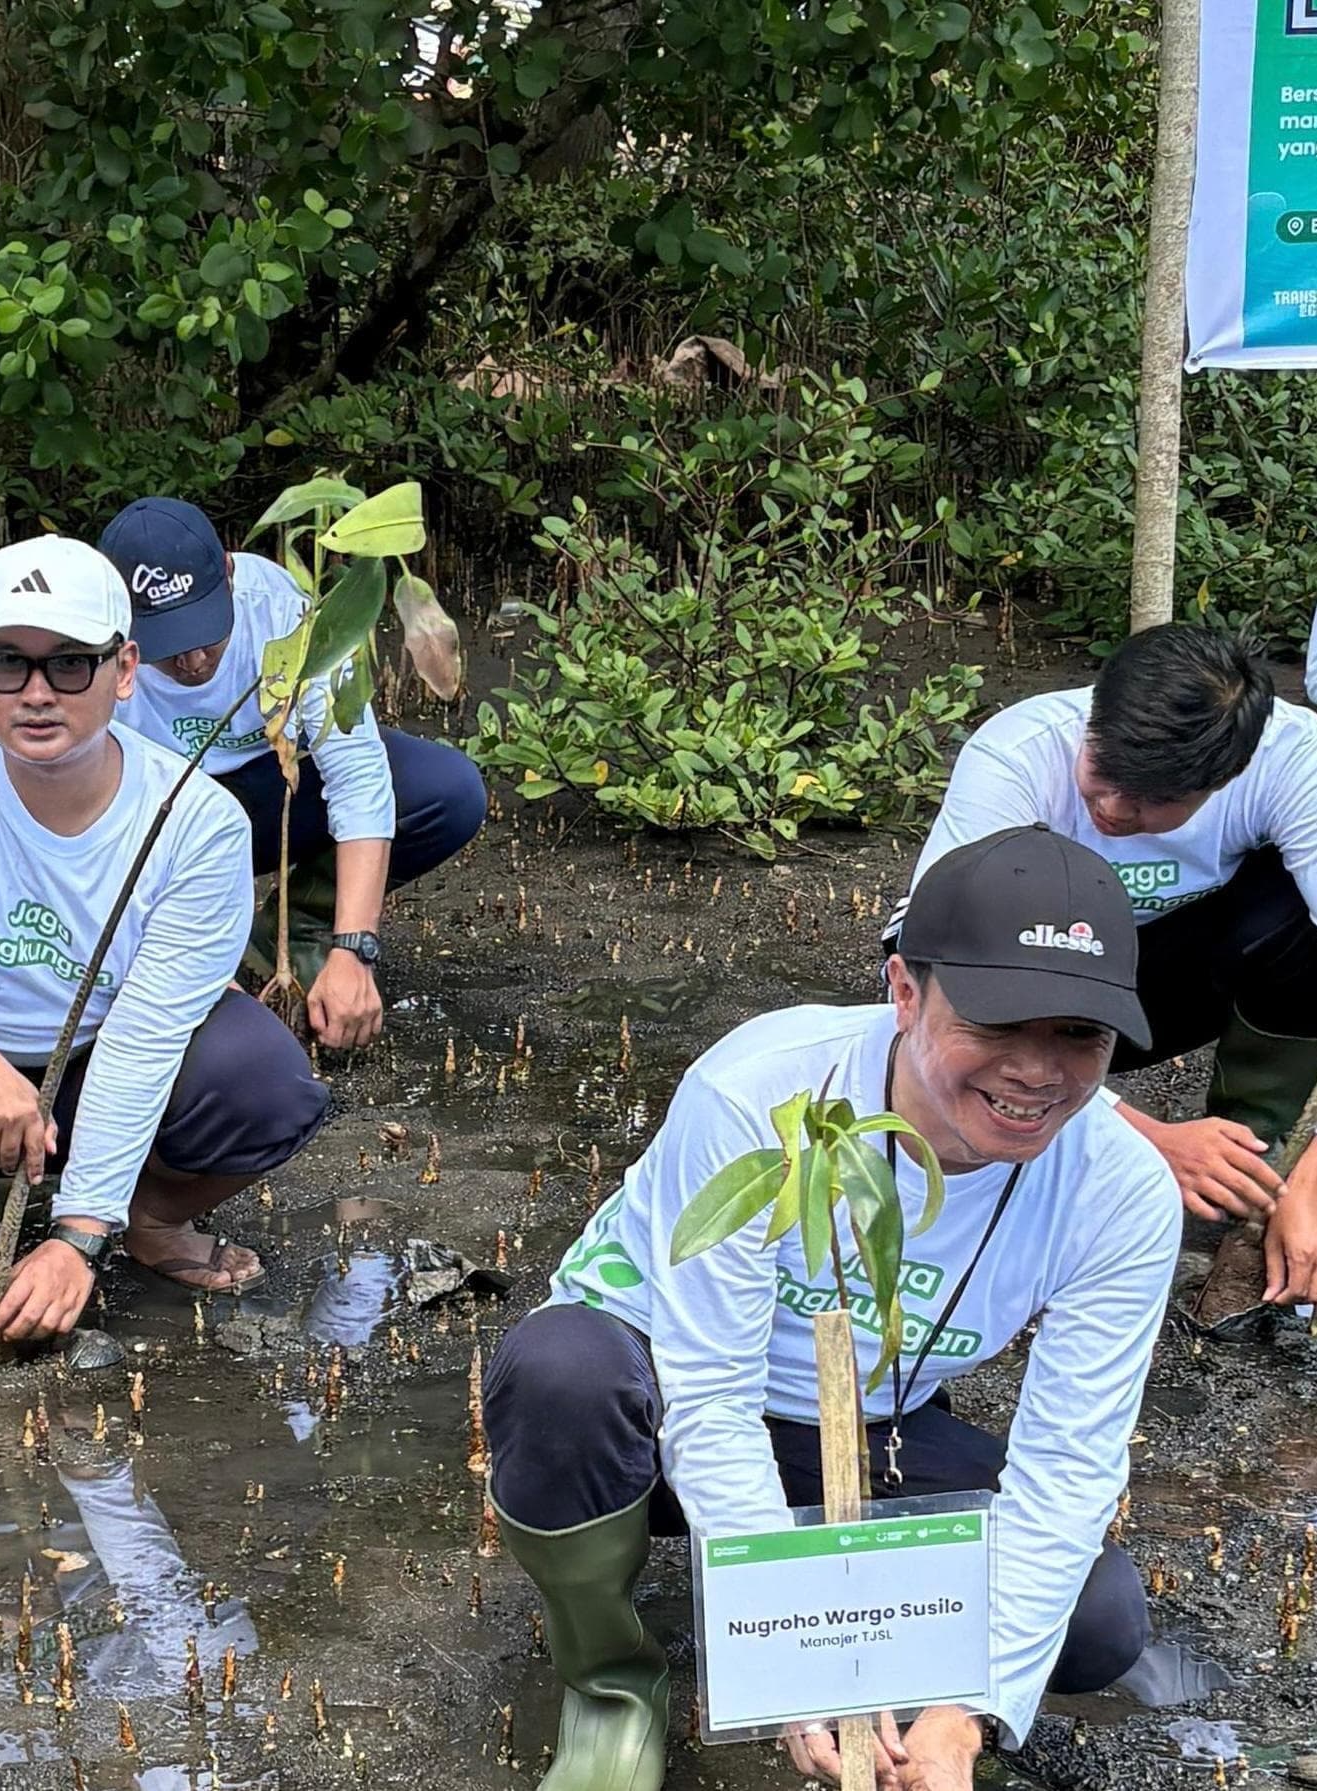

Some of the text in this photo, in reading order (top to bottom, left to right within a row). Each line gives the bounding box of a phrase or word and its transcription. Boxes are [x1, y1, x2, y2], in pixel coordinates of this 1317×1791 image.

[1278, 142, 1317, 161] yan
[147, 573, 193, 599] asdp
[1112, 862, 1176, 892] aga
[9, 900, 71, 944] Jaga
[1018, 923, 1105, 956] ellesse
[728, 1598, 964, 1638] Nugroho Wargo Susilo
[800, 1631, 893, 1649] Manajer TJSL
